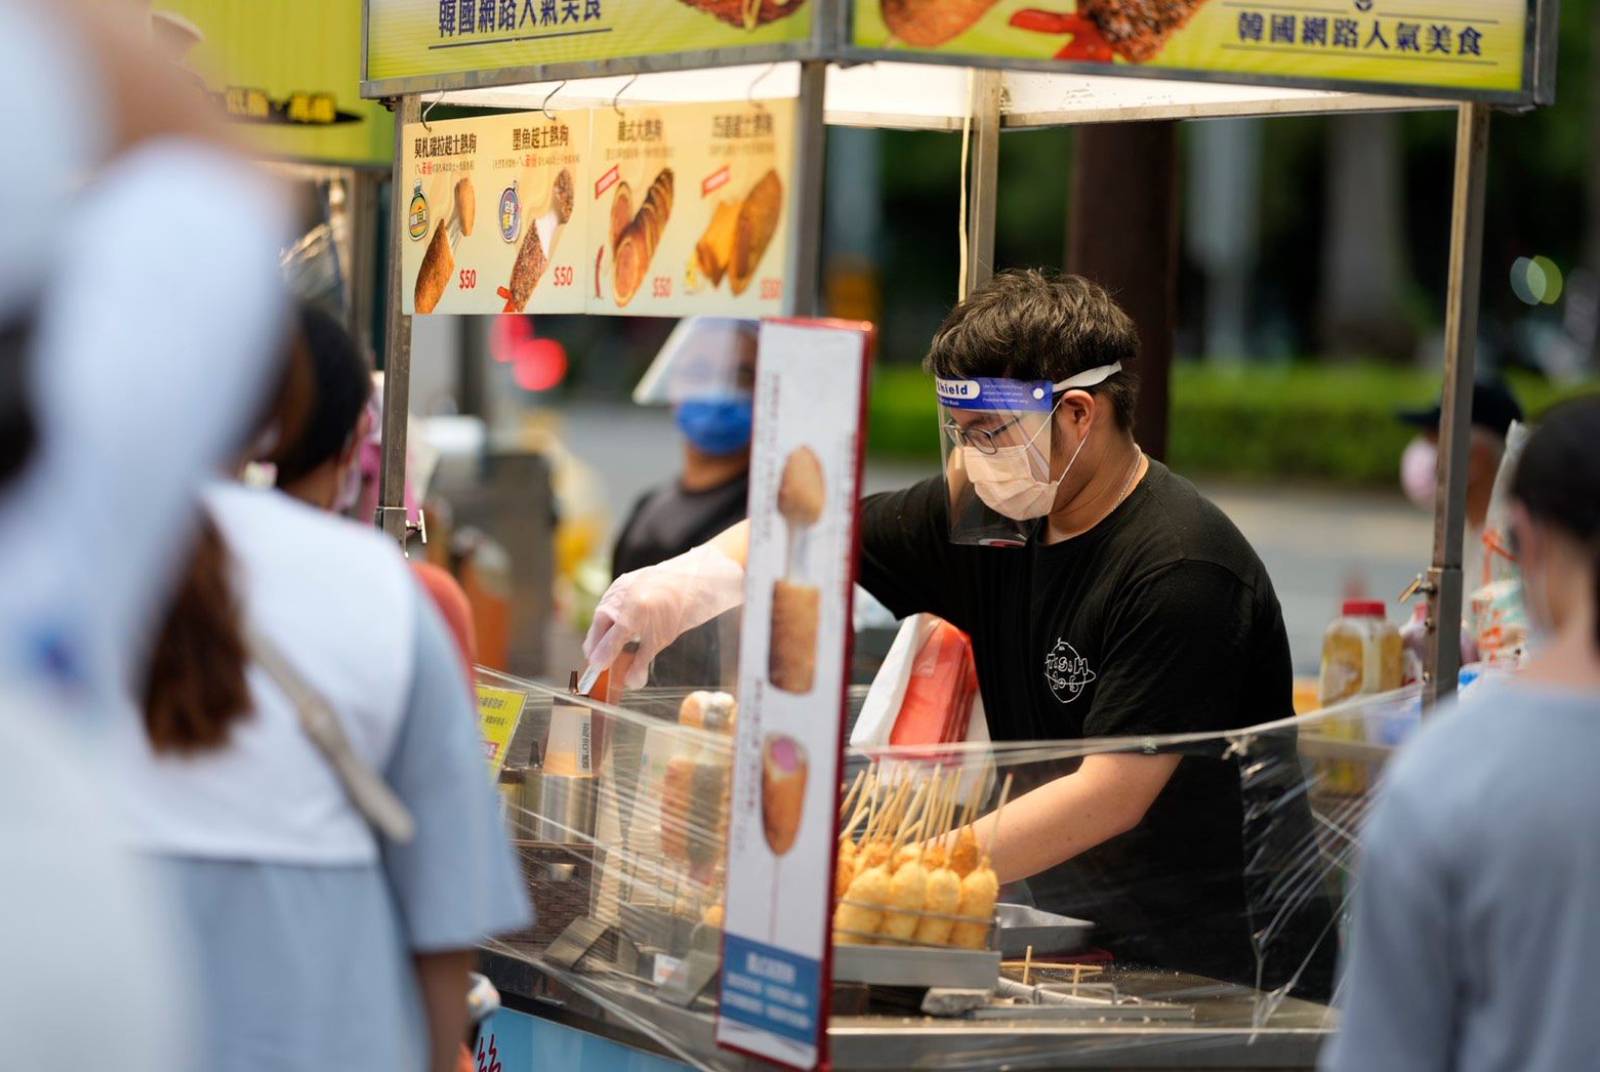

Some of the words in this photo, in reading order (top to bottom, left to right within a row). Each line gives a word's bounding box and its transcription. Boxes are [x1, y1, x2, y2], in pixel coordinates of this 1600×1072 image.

[1238, 11, 1483, 56] 韓國網路人氣美食
[414, 133, 478, 159] 莫札瑞拉起士熱狗
[512, 124, 570, 151] 墨魚起士熱狗
[459, 269, 477, 290] $50
[553, 266, 574, 287] $50
